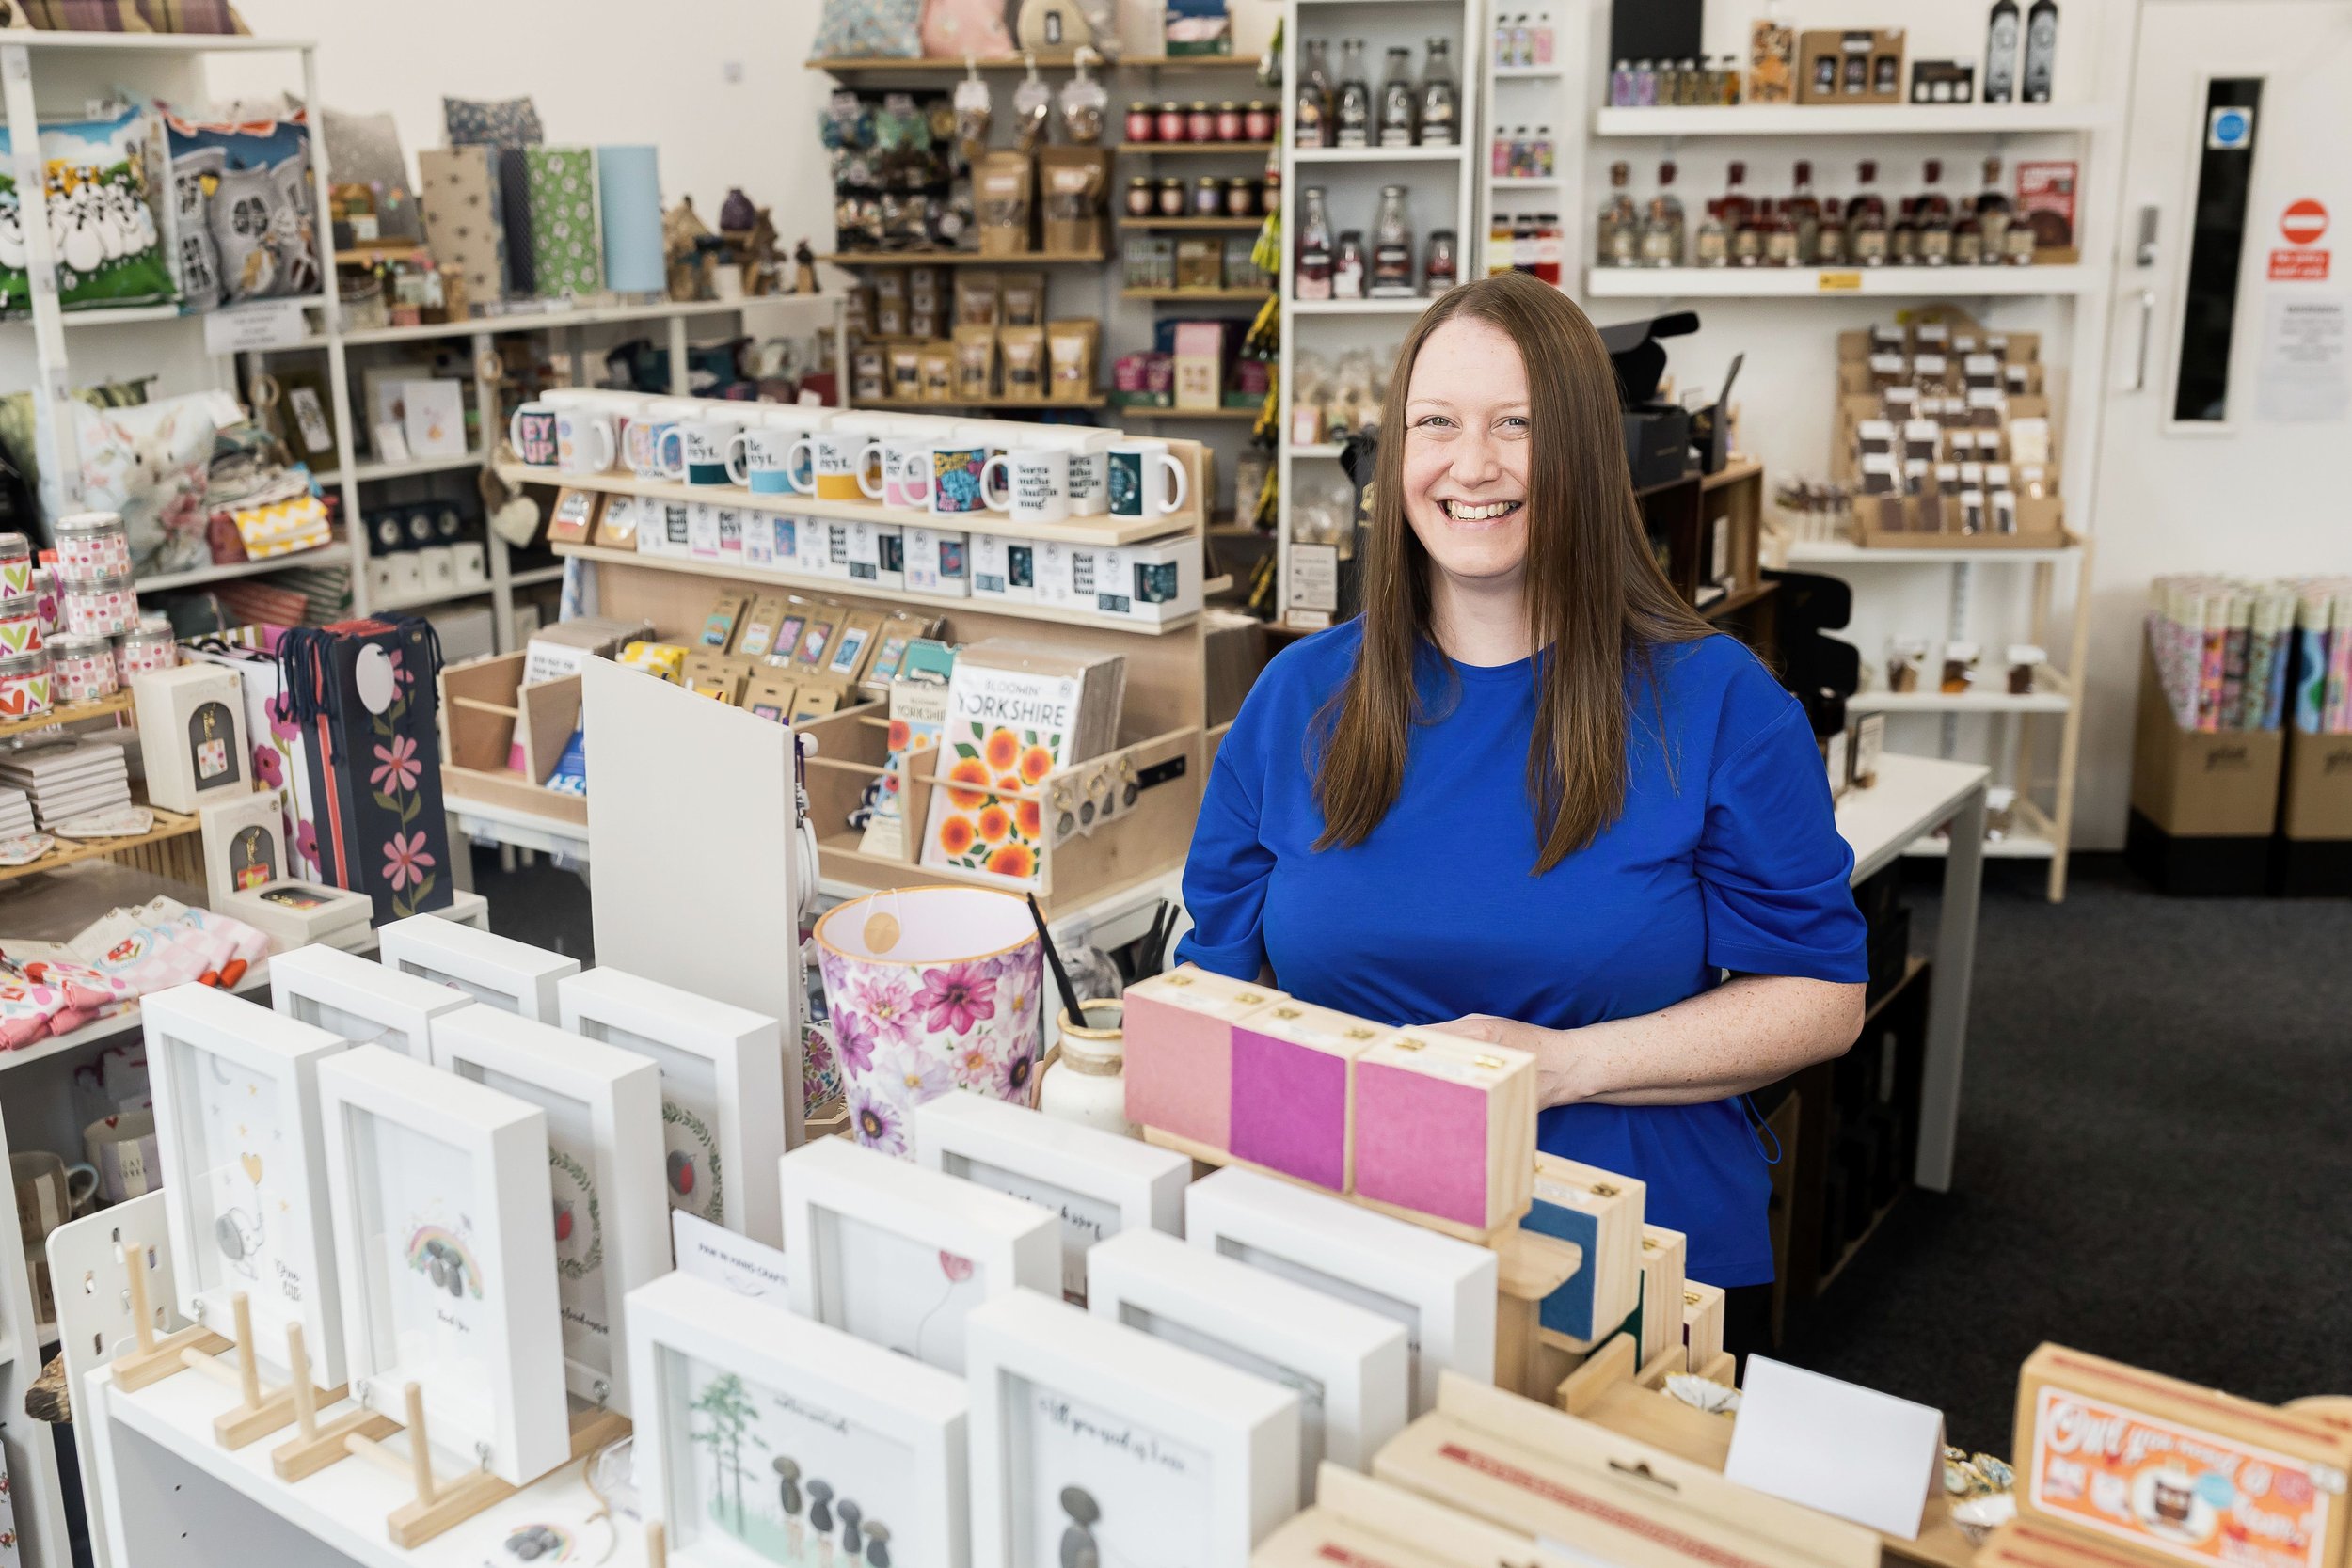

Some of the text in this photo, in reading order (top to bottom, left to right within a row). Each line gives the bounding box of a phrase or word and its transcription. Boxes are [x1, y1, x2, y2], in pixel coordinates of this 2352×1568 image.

[522, 416, 554, 441] EY
[687, 433, 704, 445] Be
[819, 443, 837, 456] Be
[885, 449, 903, 462] Be
[986, 679, 1041, 696] BLOOMIN'
[957, 692, 1066, 728] YORKSHIRE
